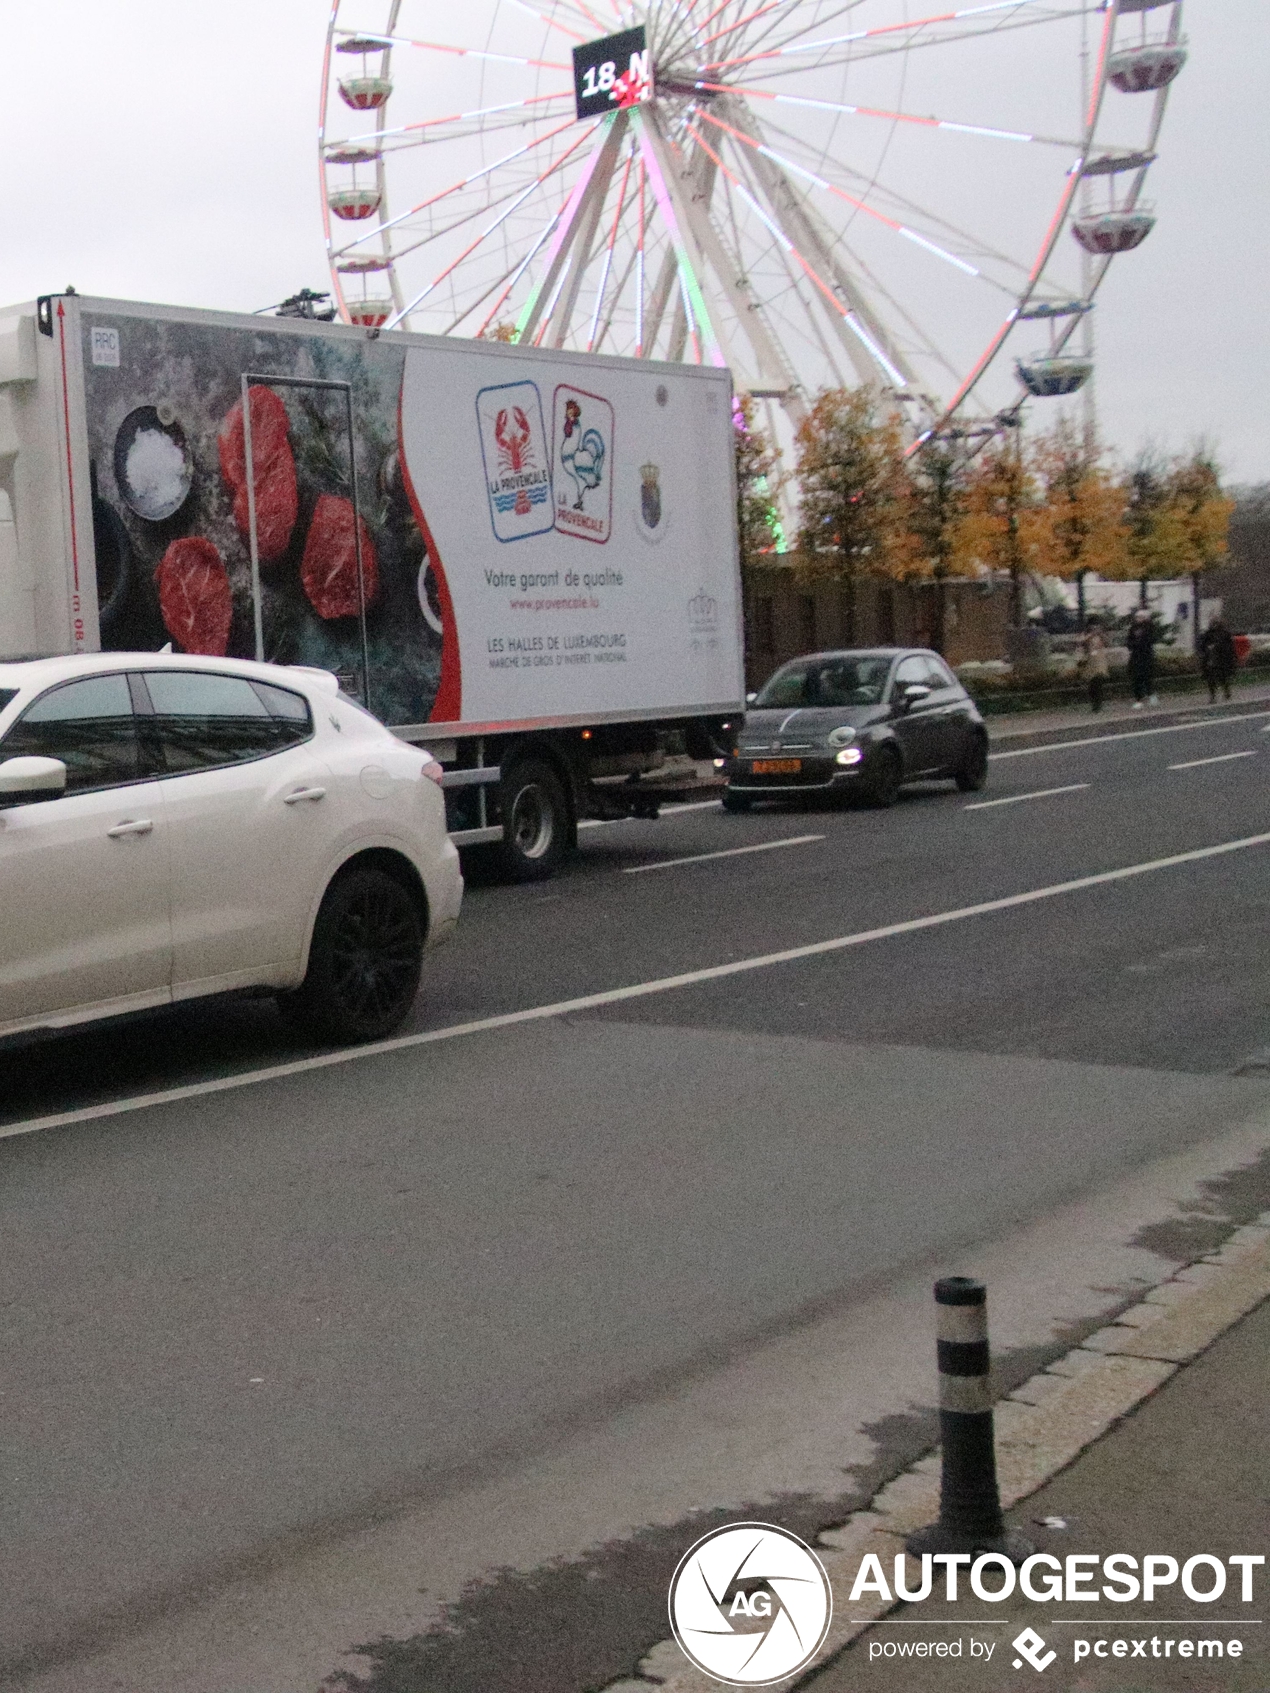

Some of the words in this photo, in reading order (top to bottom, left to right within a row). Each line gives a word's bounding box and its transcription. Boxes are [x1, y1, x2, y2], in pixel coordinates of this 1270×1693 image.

[484, 568, 517, 587] Votre
[520, 570, 559, 592] garant
[564, 568, 580, 587] de
[583, 567, 624, 590] qualité
[487, 638, 505, 653] LES
[508, 636, 544, 651] HALLES
[547, 636, 560, 650] DE
[563, 633, 627, 649] LUXEMBOURG
